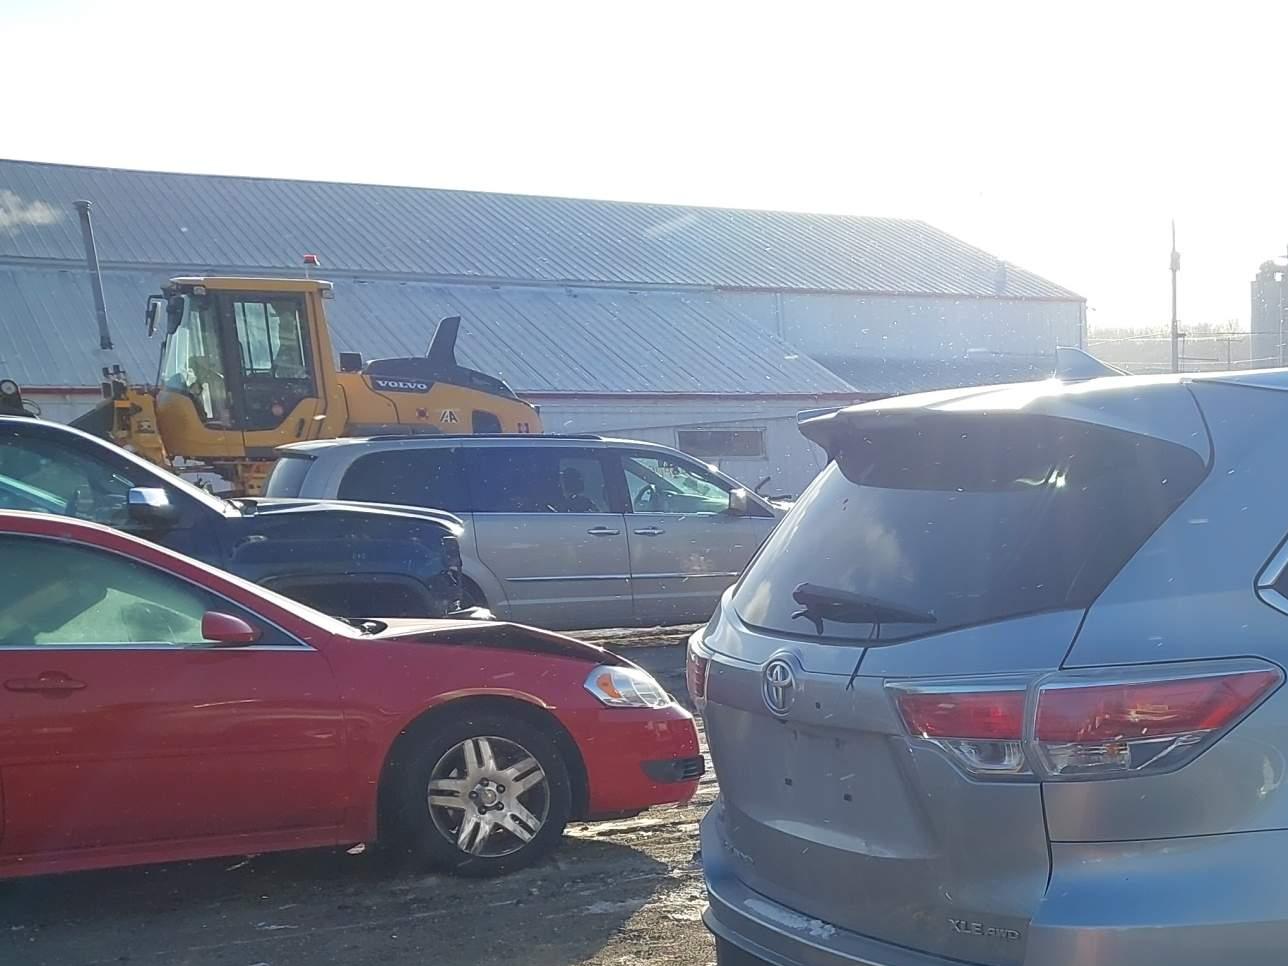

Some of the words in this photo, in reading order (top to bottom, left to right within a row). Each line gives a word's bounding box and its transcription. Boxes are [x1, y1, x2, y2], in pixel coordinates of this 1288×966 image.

[376, 380, 428, 390] VOLVO
[948, 919, 984, 936] XLE
[985, 927, 1021, 941] AWD
